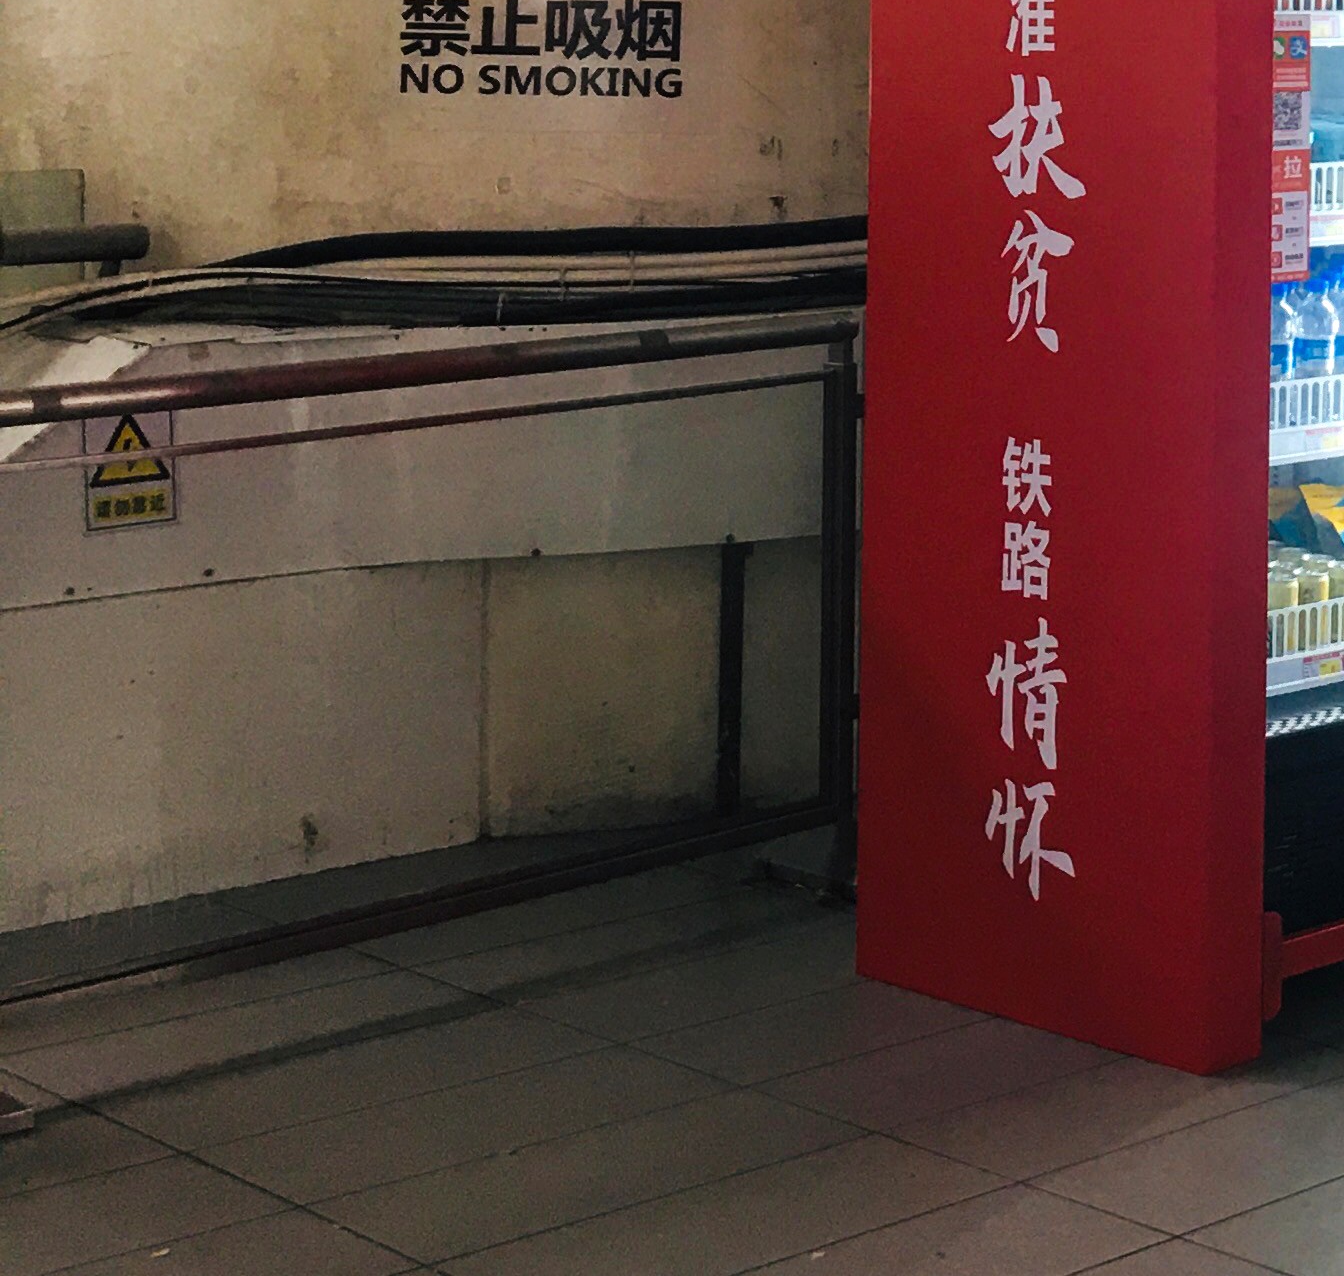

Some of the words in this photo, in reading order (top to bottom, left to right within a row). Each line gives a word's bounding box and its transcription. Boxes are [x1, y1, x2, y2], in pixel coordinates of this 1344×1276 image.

[400, 63, 464, 94] NO
[478, 65, 683, 98] SMOKING
[985, 436, 1076, 901] 铁路情怀
